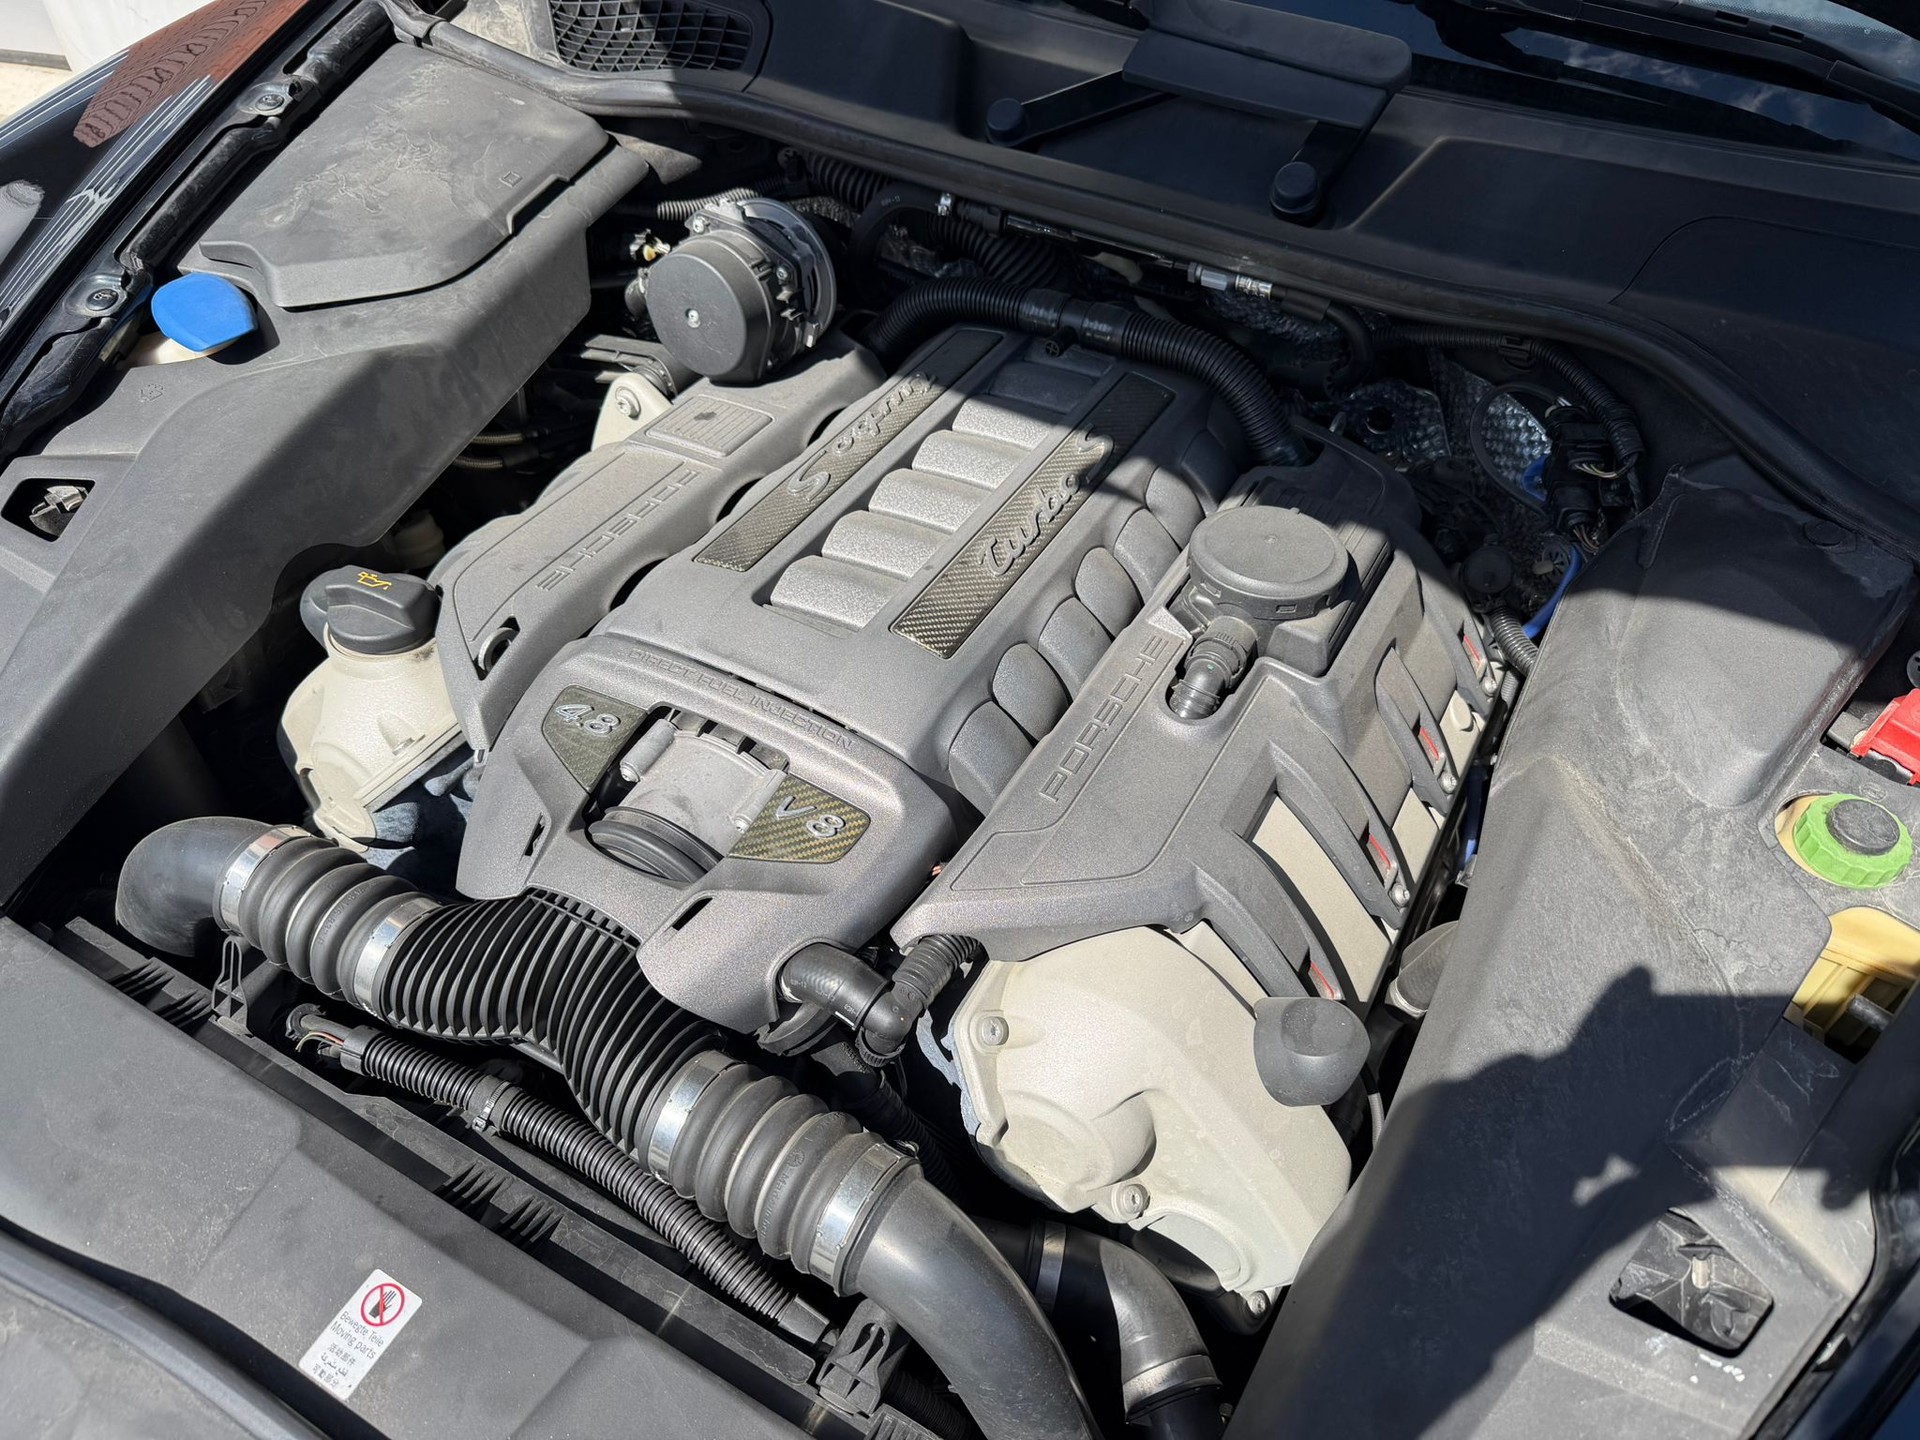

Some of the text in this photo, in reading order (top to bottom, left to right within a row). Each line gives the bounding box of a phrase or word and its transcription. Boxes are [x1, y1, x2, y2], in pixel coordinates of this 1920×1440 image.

[787, 371, 937, 501] Turbo S
[536, 469, 700, 591] PORSCHE
[980, 422, 1115, 576] Turbo S
[555, 704, 621, 735] 4.8
[628, 648, 857, 750] DIRECT FUEL INJECTION
[1039, 635, 1169, 802] PORSCHE
[330, 1320, 377, 1360] Moving parts
[340, 1310, 385, 1348] Bewegte Teile
